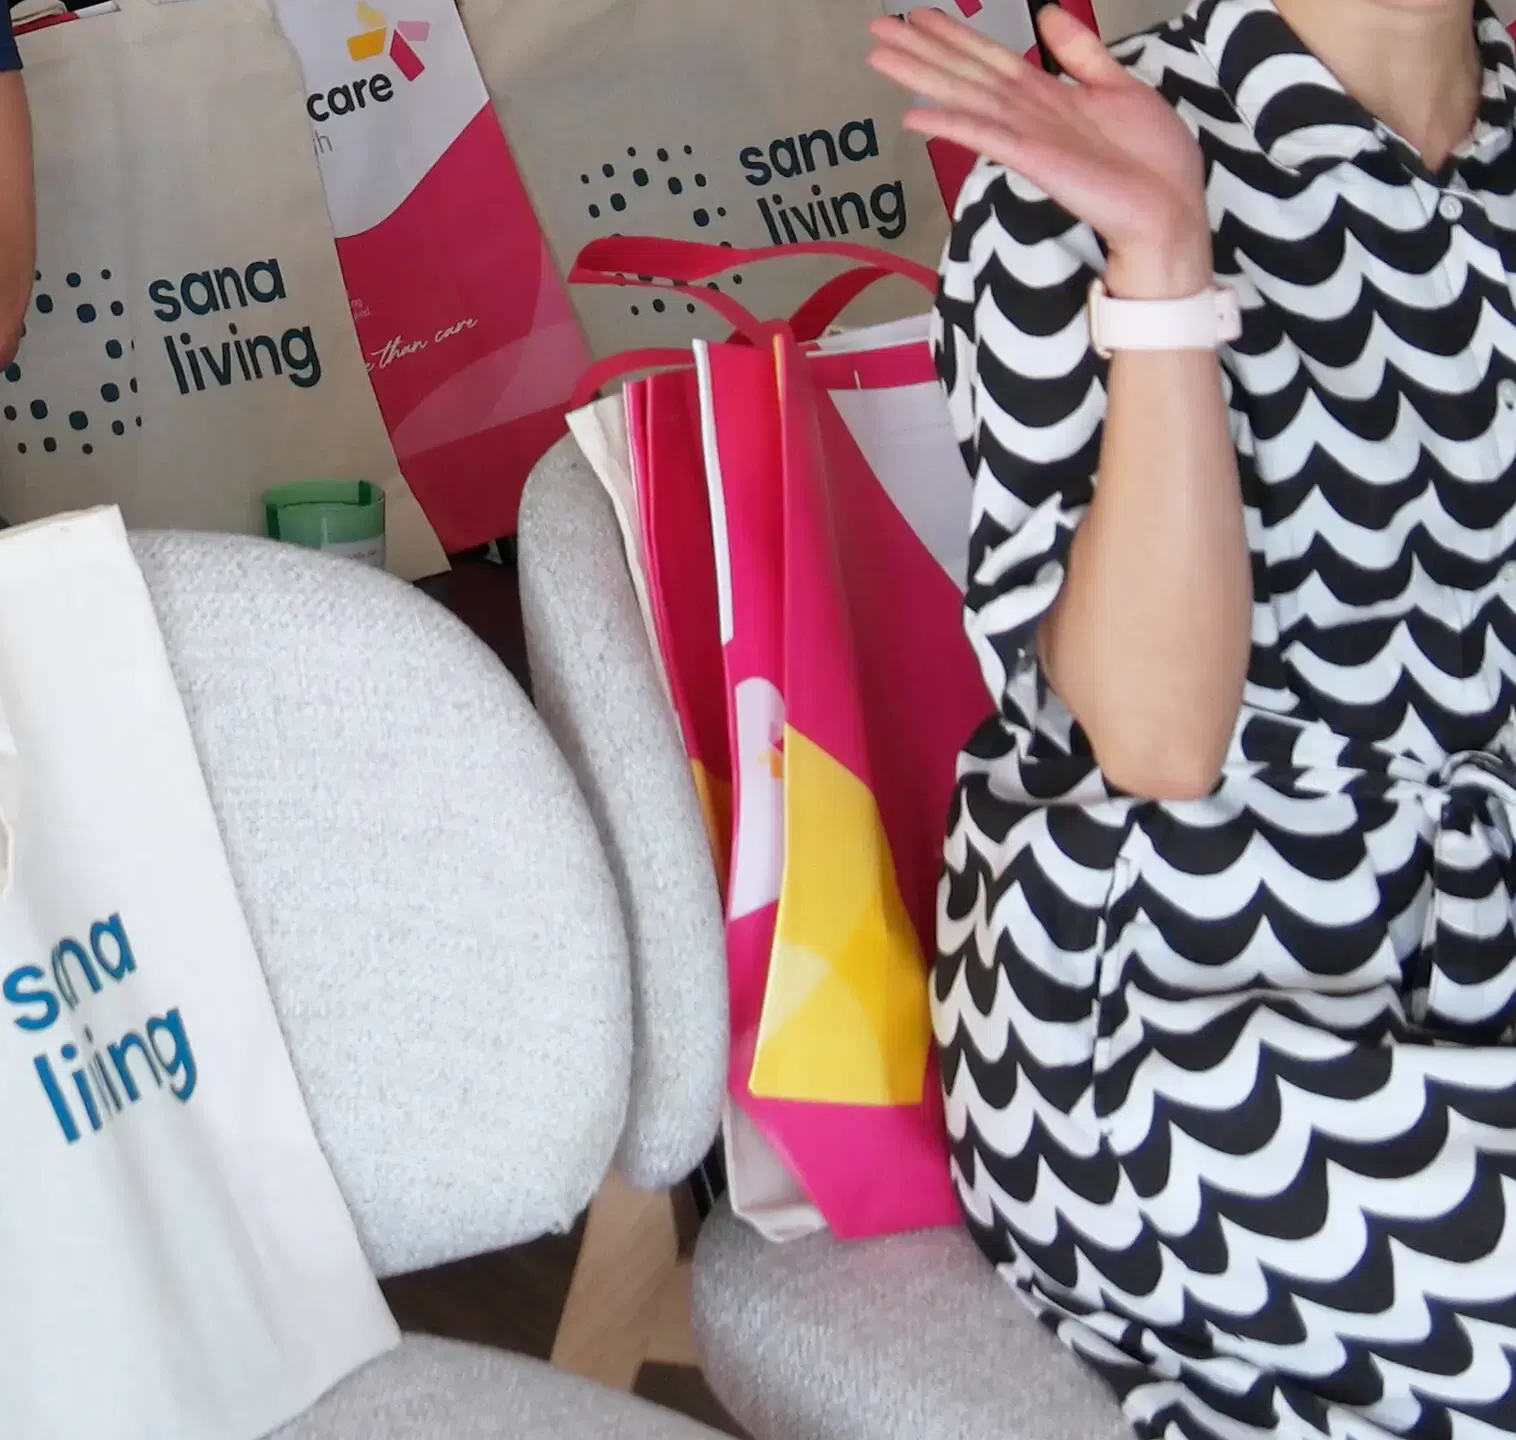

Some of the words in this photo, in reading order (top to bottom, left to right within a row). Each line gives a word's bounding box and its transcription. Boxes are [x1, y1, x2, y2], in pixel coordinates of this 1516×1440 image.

[306, 73, 394, 122] care
[739, 118, 879, 186] sana
[756, 180, 907, 246] living
[148, 258, 287, 322] sana
[164, 323, 322, 395] living
[371, 335, 428, 368] than
[434, 318, 479, 342] care
[33, 1005, 197, 1145] liing
